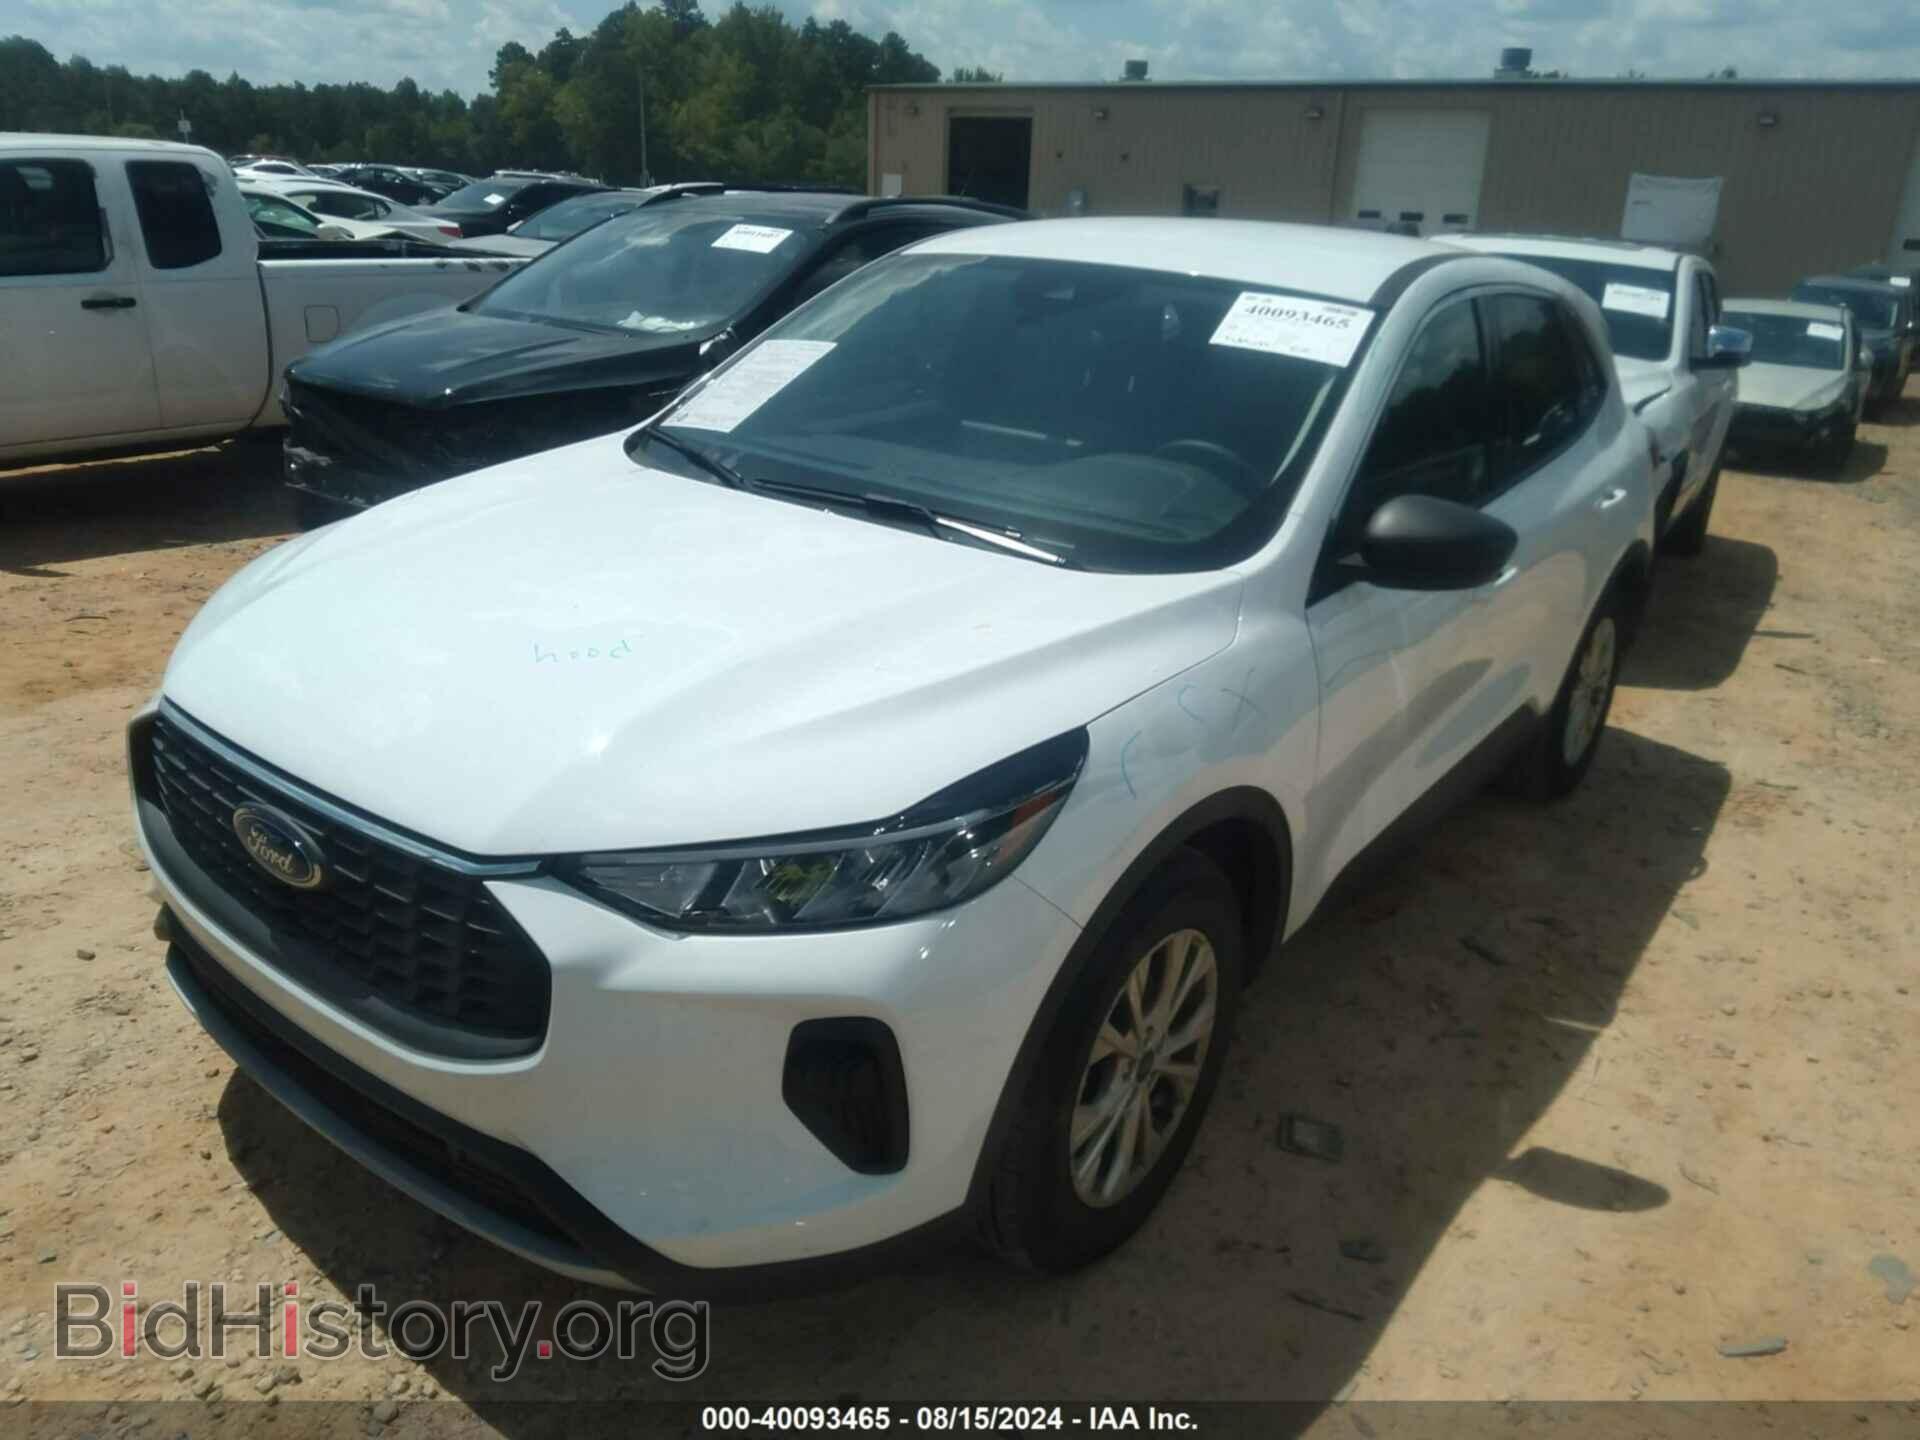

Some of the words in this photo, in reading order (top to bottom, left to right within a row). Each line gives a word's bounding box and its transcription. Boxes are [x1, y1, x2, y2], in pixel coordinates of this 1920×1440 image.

[1244, 304, 1352, 329] 40093465
[533, 639, 632, 663] hood
[246, 824, 294, 874] Ford
